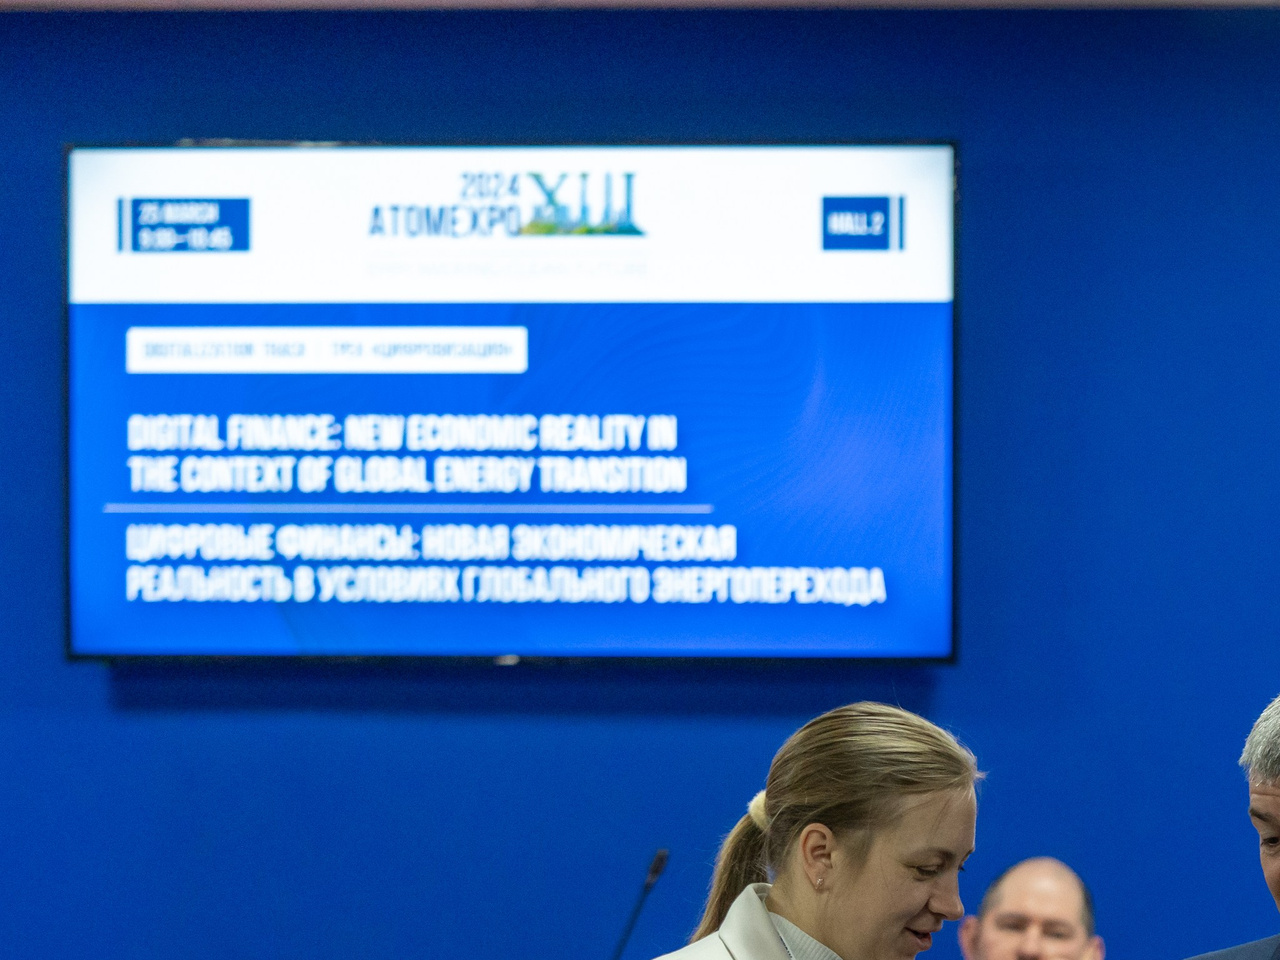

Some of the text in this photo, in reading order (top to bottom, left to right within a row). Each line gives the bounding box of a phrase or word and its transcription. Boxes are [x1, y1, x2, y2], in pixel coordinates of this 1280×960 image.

[460, 171, 521, 199] 2024
[369, 204, 522, 237] ATOMEXPO
[127, 414, 678, 451] DIGITAL FINANCE: NEW ECONOMIC REALITY IN
[127, 456, 688, 493] THE CONTEXT OF GLOBAL ENERGY TRANSITION
[126, 524, 275, 562] ЦИФРОВЫЕ
[422, 524, 509, 561] НОВАЯ
[512, 524, 737, 561] ЭКОНОМИЧЕСКАЯ
[126, 565, 887, 606] РЕАЛЬНОСТЬ В УСЛОВИЯХ ГЛОБАЛЬНОГО ЭНЕРГОПЕРЕХОДА
